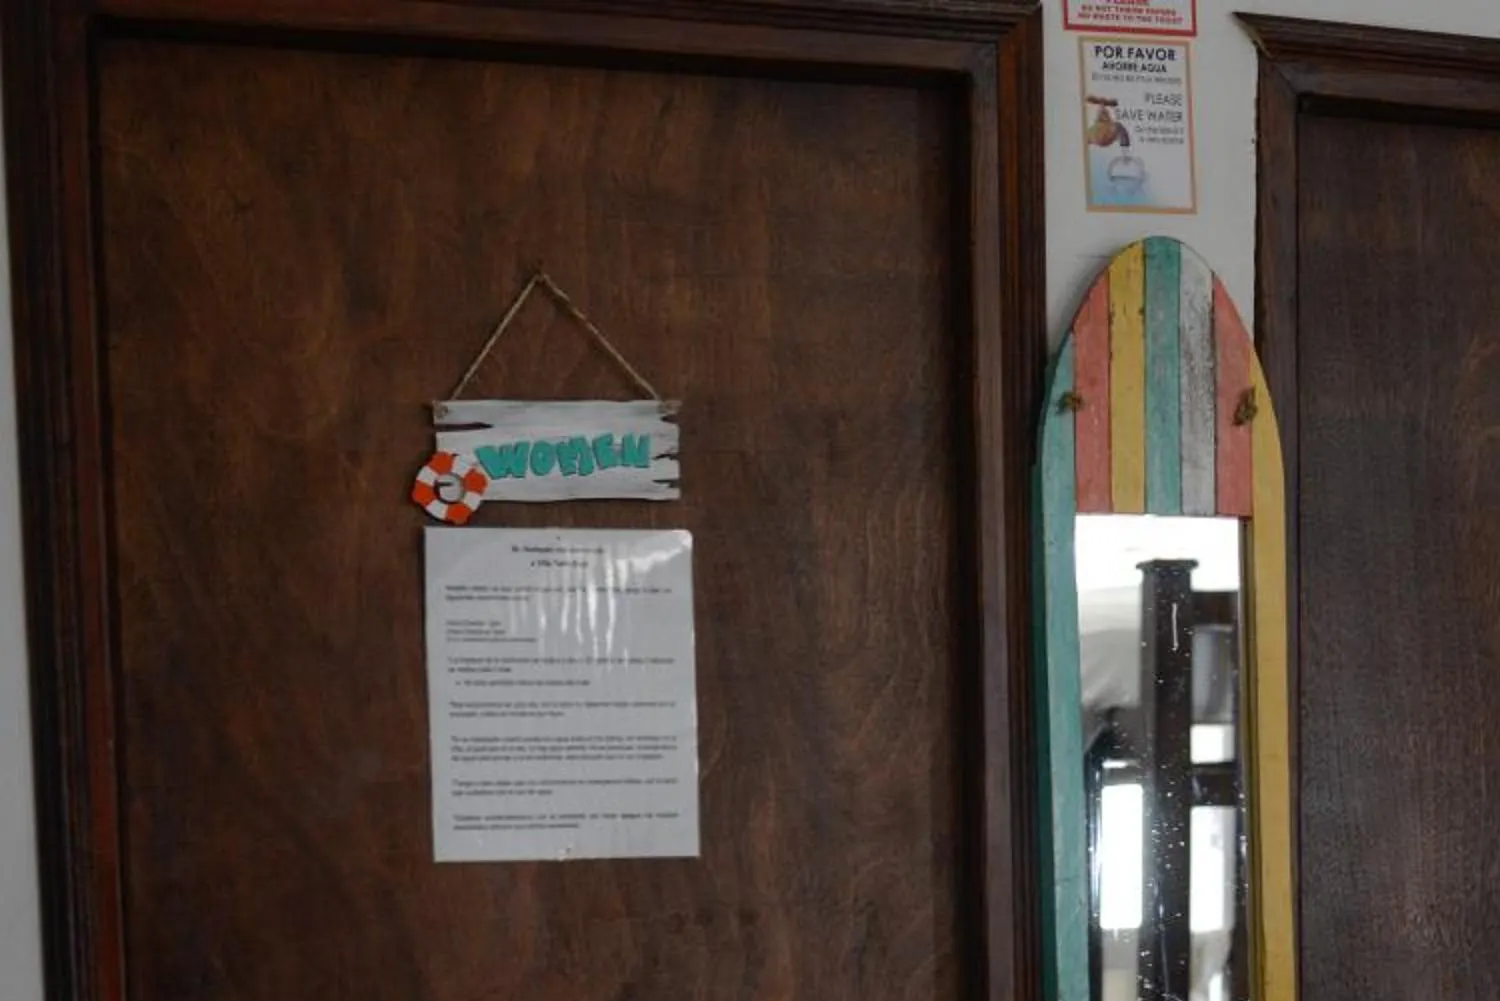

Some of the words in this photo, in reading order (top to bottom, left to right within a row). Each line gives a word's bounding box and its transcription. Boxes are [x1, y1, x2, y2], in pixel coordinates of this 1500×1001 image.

[1094, 45, 1123, 59] POR
[1127, 46, 1176, 61] FAVOR
[1140, 63, 1167, 73] AGUA
[1145, 92, 1183, 106] PLEASE
[1115, 108, 1144, 121] SAVE
[1146, 110, 1183, 122] WATER
[474, 432, 652, 480] WOMEN
